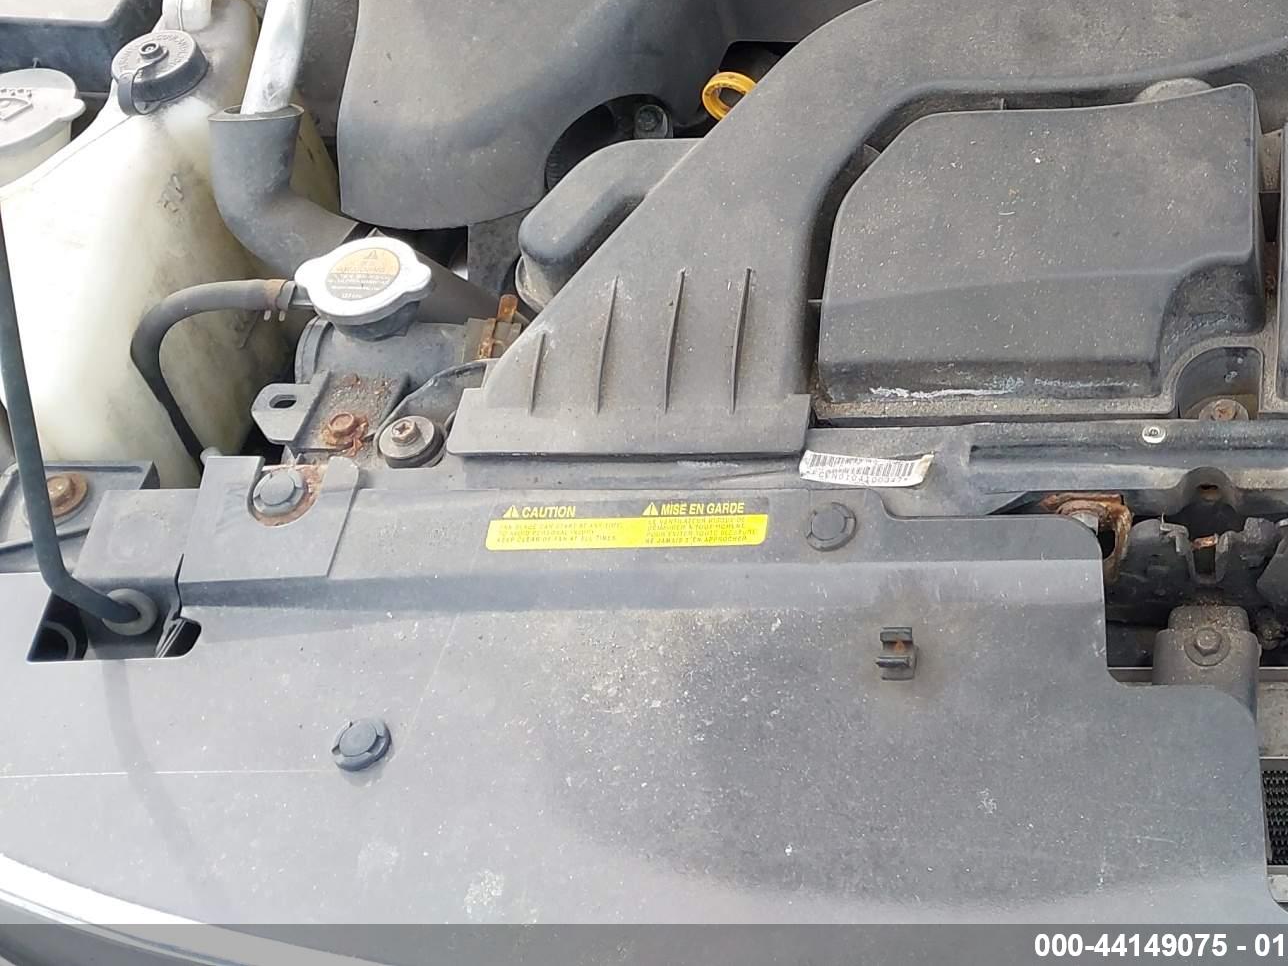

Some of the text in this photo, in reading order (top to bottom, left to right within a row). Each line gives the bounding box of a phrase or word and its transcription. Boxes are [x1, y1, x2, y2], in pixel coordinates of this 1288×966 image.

[521, 506, 577, 518] CAUTION
[660, 502, 746, 516] MISE EN GARDE
